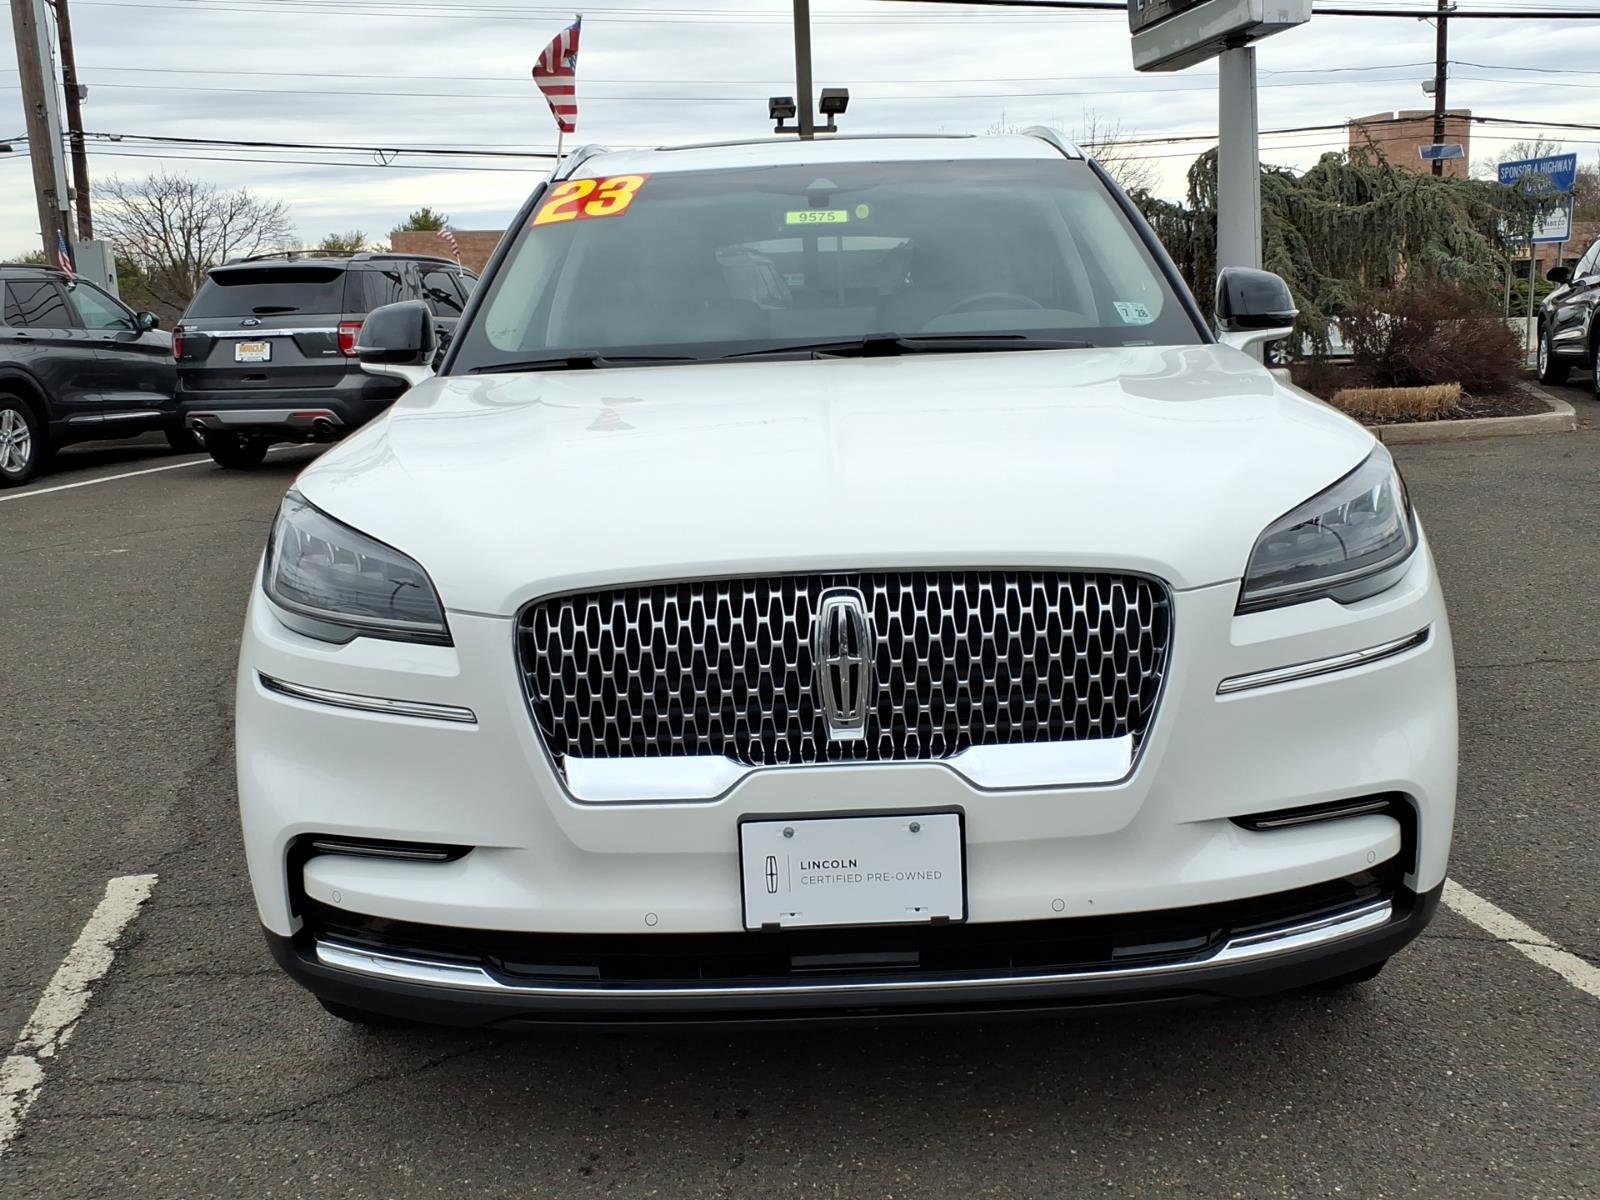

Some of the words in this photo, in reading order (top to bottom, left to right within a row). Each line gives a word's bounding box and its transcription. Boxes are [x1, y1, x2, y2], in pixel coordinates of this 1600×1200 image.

[1500, 164, 1532, 180] SPONSOR
[1533, 164, 1539, 173] A
[1540, 158, 1574, 174] HIGHWAY
[533, 175, 645, 226] 23
[799, 212, 836, 222] 9575
[800, 859, 857, 870] LINCOLN
[800, 873, 863, 885] CERTIFIED
[867, 870, 942, 882] PRE-OWNED
